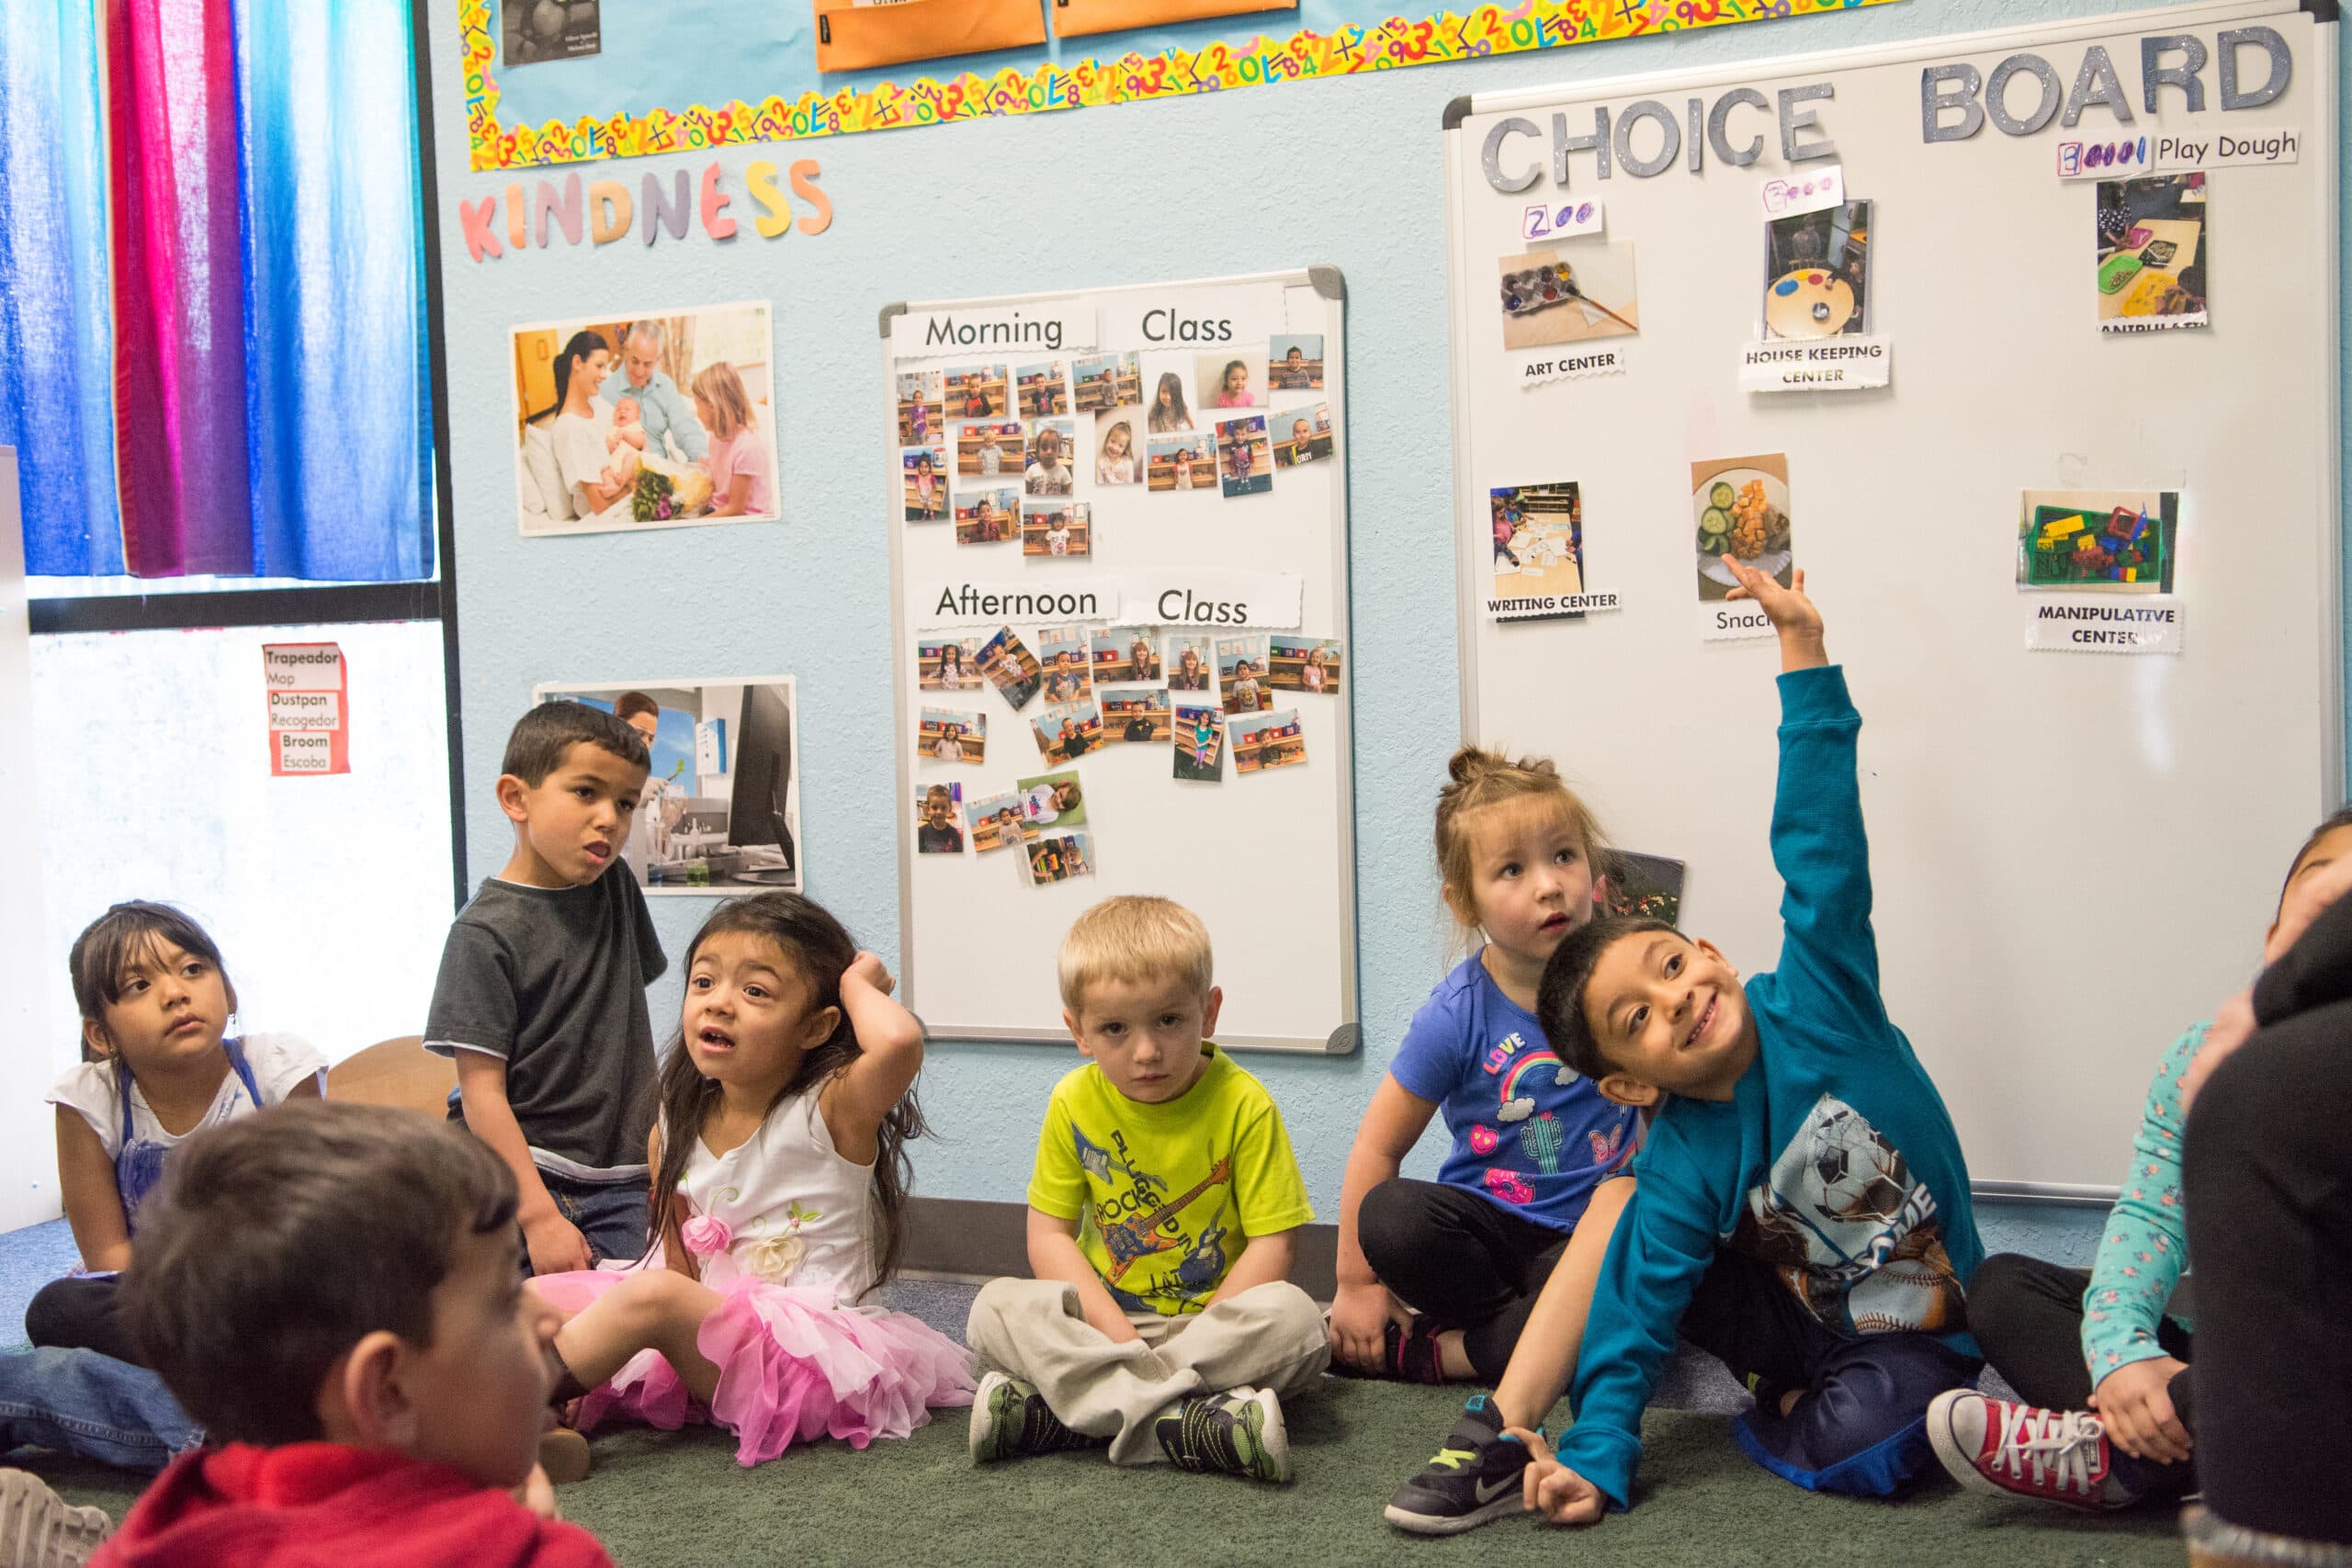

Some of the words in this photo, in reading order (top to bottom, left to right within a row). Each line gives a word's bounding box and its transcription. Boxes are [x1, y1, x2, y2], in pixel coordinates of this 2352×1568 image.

[1481, 82, 1835, 193] CHOICE
[1920, 26, 2293, 144] BOARD
[2160, 137, 2209, 165] Play
[2219, 130, 2296, 161] Dough
[459, 159, 833, 263] KINDNESS
[925, 311, 1063, 350] Morning
[1142, 308, 1232, 342] Class
[1747, 349, 1803, 365] HOUSE
[1808, 344, 1883, 361] KEEPING
[1525, 362, 1554, 377] ART
[1558, 353, 1615, 372] CENTER
[1782, 368, 1845, 384] CENTER
[935, 584, 1097, 615] Afternoon
[1158, 589, 1248, 625] Class
[1487, 597, 1555, 612] WRITING
[1560, 594, 1617, 608] CENTER
[2038, 606, 2176, 623] MANIPULATIVE
[2072, 629, 2139, 645] CENTER
[266, 650, 339, 667] Trapeador
[266, 672, 295, 686] Mop
[271, 693, 327, 710] Dustpan
[271, 713, 337, 730] Recogedor
[283, 735, 328, 748] Broom
[283, 755, 326, 768] Escoba
[1482, 1032, 1526, 1076] LOVE
